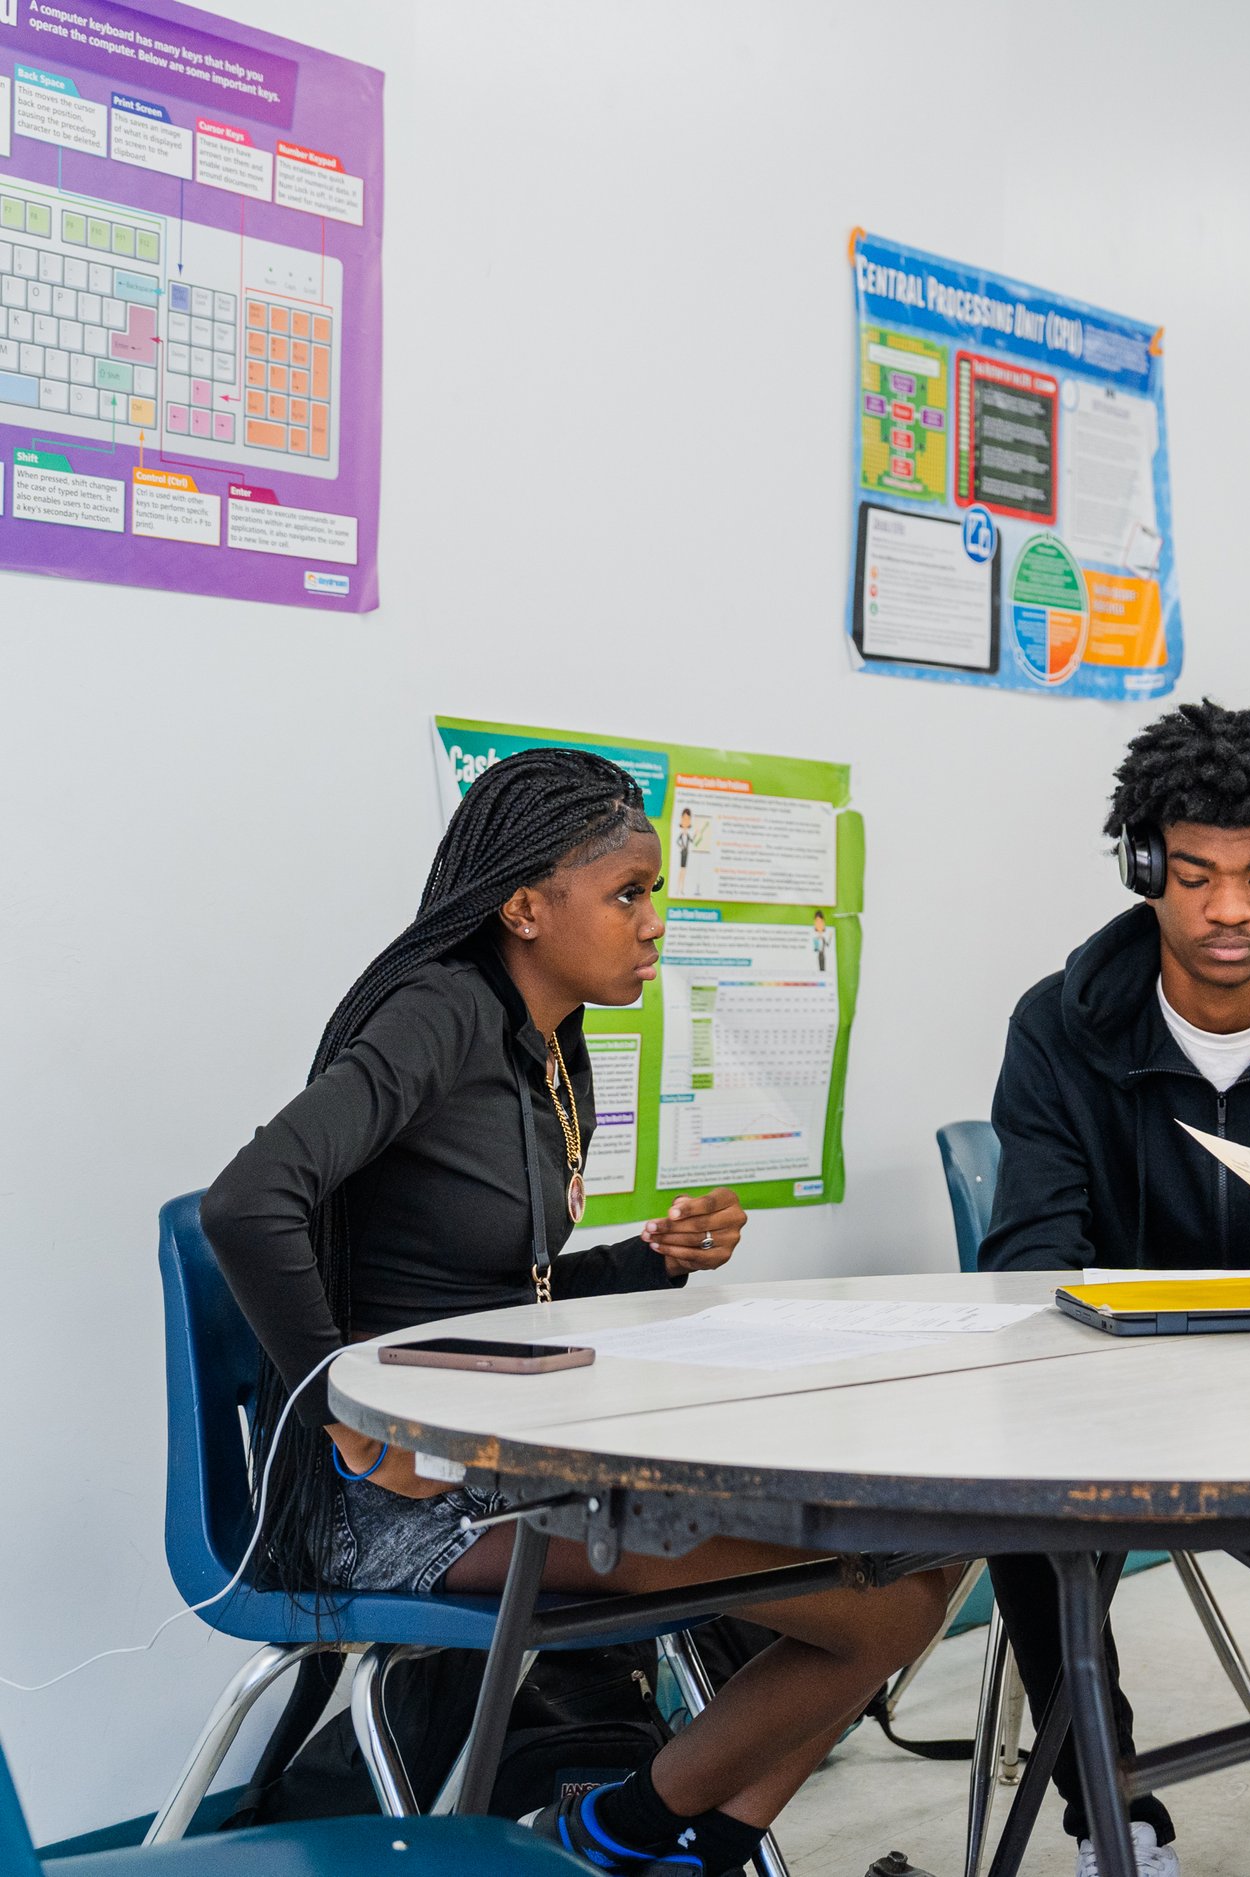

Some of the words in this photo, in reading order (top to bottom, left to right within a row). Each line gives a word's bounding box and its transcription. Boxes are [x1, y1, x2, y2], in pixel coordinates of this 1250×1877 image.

[29, 0, 38, 11] A
[40, 4, 88, 27] computer
[89, 17, 134, 42] keyboard
[136, 32, 153, 47] has
[154, 40, 181, 58] many
[182, 46, 203, 64] keys
[204, 54, 223, 70] that
[225, 60, 245, 78] help
[246, 68, 264, 83] you
[29, 18, 69, 37] operate
[70, 29, 87, 43] the
[89, 36, 137, 58] computer.
[138, 49, 168, 67] Below
[169, 60, 185, 73] are
[186, 65, 211, 81] some
[211, 71, 257, 96] important
[257, 86, 281, 103] keys.
[17, 67, 39, 81] Back
[39, 75, 65, 89] Space
[17, 97, 34, 108] back
[37, 103, 51, 112] one
[18, 85, 33, 96] This
[34, 92, 58, 104] moves
[60, 98, 72, 107] the
[74, 103, 96, 113] cursor
[113, 95, 134, 110] Print
[134, 102, 163, 118] Screen
[17, 109, 46, 123] causing
[47, 116, 59, 126] the
[61, 121, 97, 138] preceding
[17, 120, 51, 134] character
[53, 128, 60, 137] to
[62, 131, 72, 140] be
[114, 112, 128, 122] This
[129, 119, 148, 129] saves
[160, 127, 181, 139] image
[198, 120, 225, 135] Cursor
[225, 128, 245, 142] Keys
[114, 125, 122, 133] of
[123, 127, 141, 138] what
[149, 135, 182, 150] displayed
[199, 136, 218, 147] These
[220, 145, 234, 155] keys
[236, 147, 251, 158] have
[124, 140, 146, 151] screen
[148, 145, 156, 153] to
[156, 148, 168, 157] the
[279, 143, 308, 160] Number
[308, 152, 337, 168] Keypad
[222, 166, 238, 175] users
[239, 169, 247, 177] to
[247, 173, 264, 182] move
[233, 158, 249, 167] them
[251, 163, 263, 172] and
[199, 170, 222, 181] around
[57, 292, 64, 301] P
[856, 253, 925, 309] CENTRAL
[926, 274, 1014, 335] PROCESSING
[1014, 301, 1045, 345] UNIT
[1045, 310, 1083, 359] (CPU)
[13, 315, 20, 325] K
[39, 320, 44, 330] L
[16, 451, 39, 464] Shift
[17, 469, 38, 480] When
[40, 474, 70, 486] pressed,
[71, 478, 88, 488] shift
[89, 481, 118, 493] changes
[135, 471, 166, 484] Control
[167, 475, 188, 489] (Ctrl)
[17, 481, 31, 490] the
[31, 483, 47, 492] case
[48, 485, 56, 494] of
[58, 486, 79, 499] typed
[80, 490, 105, 501] letters.
[106, 494, 112, 502] It
[136, 487, 148, 496] Ctrl
[155, 492, 171, 500] used
[172, 493, 186, 502] with
[187, 496, 204, 505] other
[230, 486, 252, 498] Enter
[16, 492, 31, 501] also
[33, 494, 61, 506] enables
[62, 499, 81, 508] users
[83, 501, 91, 509] to
[92, 502, 120, 514] activate
[136, 498, 150, 508] keys
[160, 502, 186, 513] perform
[186, 506, 209, 517] specific
[231, 503, 243, 511] This
[251, 506, 265, 514] used
[274, 510, 298, 520] execute
[23, 503, 41, 514] key's
[43, 507, 79, 520] secondary
[81, 511, 113, 524] function.
[136, 508, 164, 520] functions
[181, 515, 193, 524] Ctrl
[231, 514, 263, 526] operations
[264, 518, 284, 527] within
[284, 521, 292, 529] an
[275, 530, 289, 538] also
[560, 1782, 600, 1799] JANS
